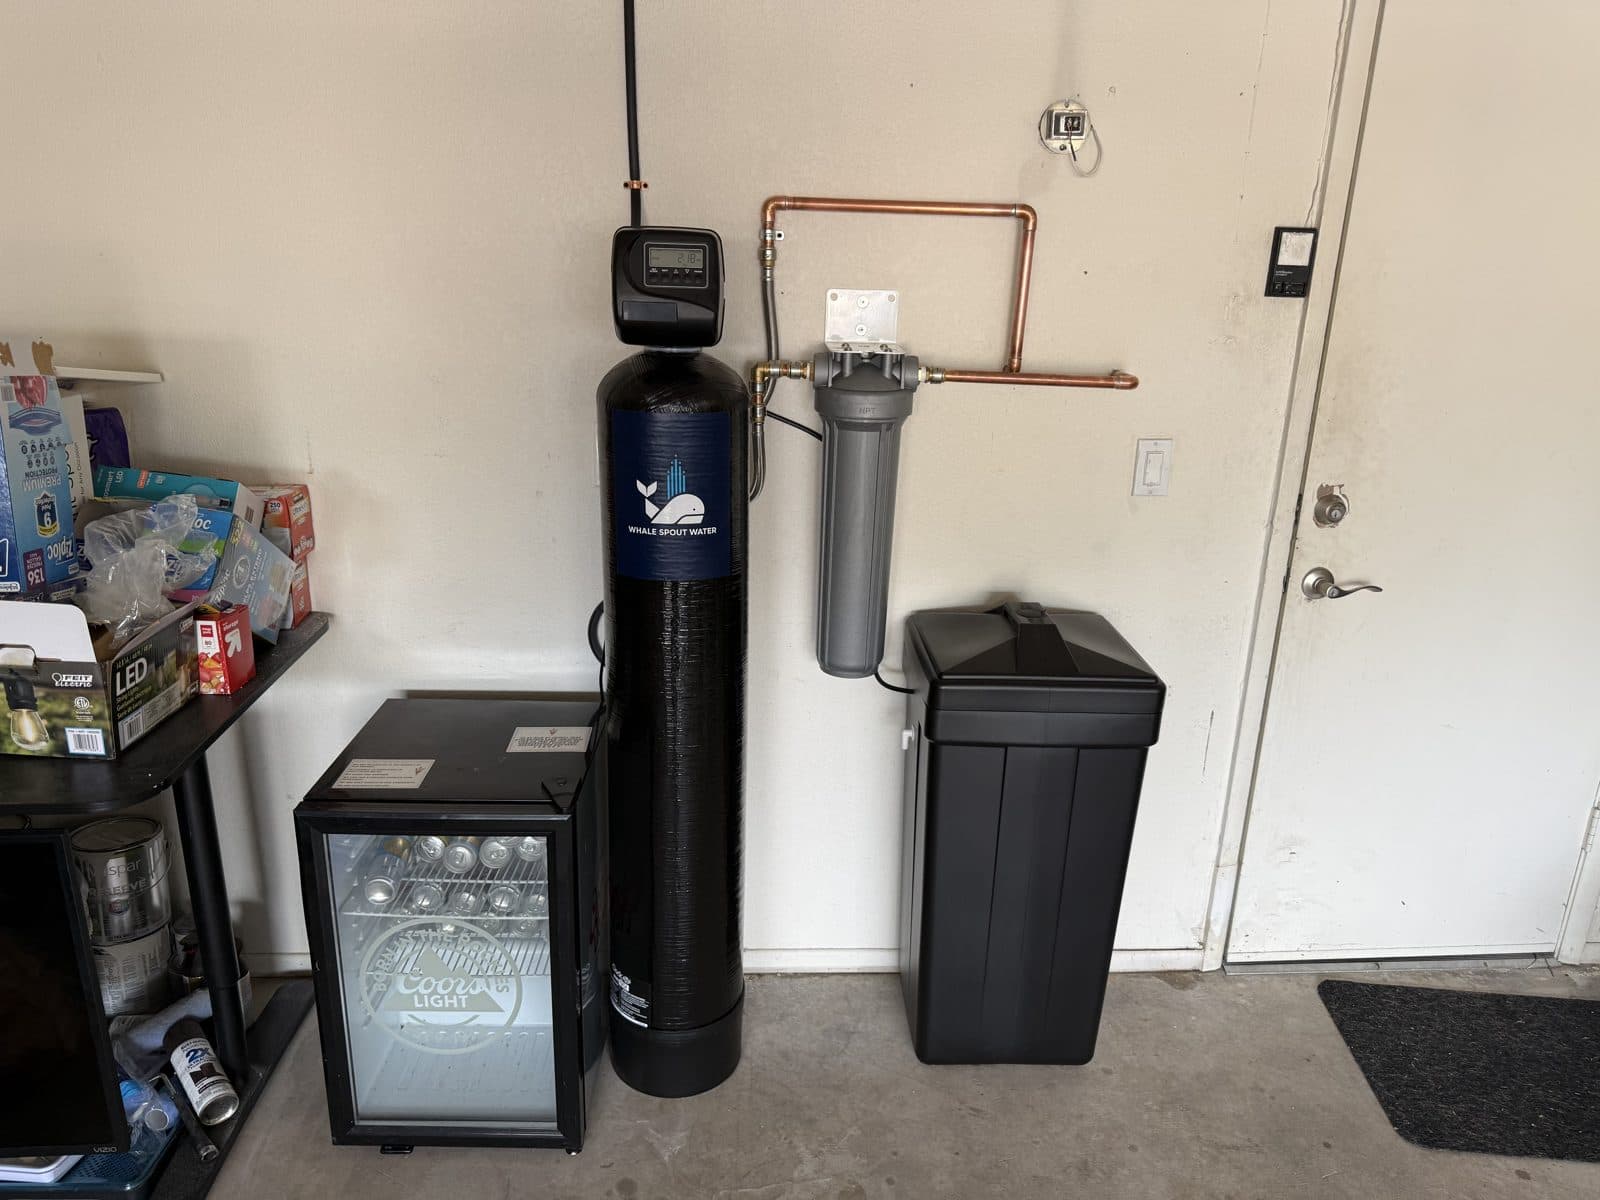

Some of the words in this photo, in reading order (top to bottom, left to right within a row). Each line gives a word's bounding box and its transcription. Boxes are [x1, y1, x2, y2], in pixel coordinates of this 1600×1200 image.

[22, 475, 62, 492] PREMIUM
[43, 511, 52, 527] 9
[628, 525, 657, 536] WHALE
[658, 528, 688, 536] SPOUT
[689, 526, 717, 536] WATER
[46, 535, 74, 562] Ziploc
[27, 567, 45, 586] 136
[63, 674, 92, 682] FEIT
[115, 657, 148, 697] LED
[397, 974, 489, 996] Coors
[414, 995, 468, 1009] LIGHT
